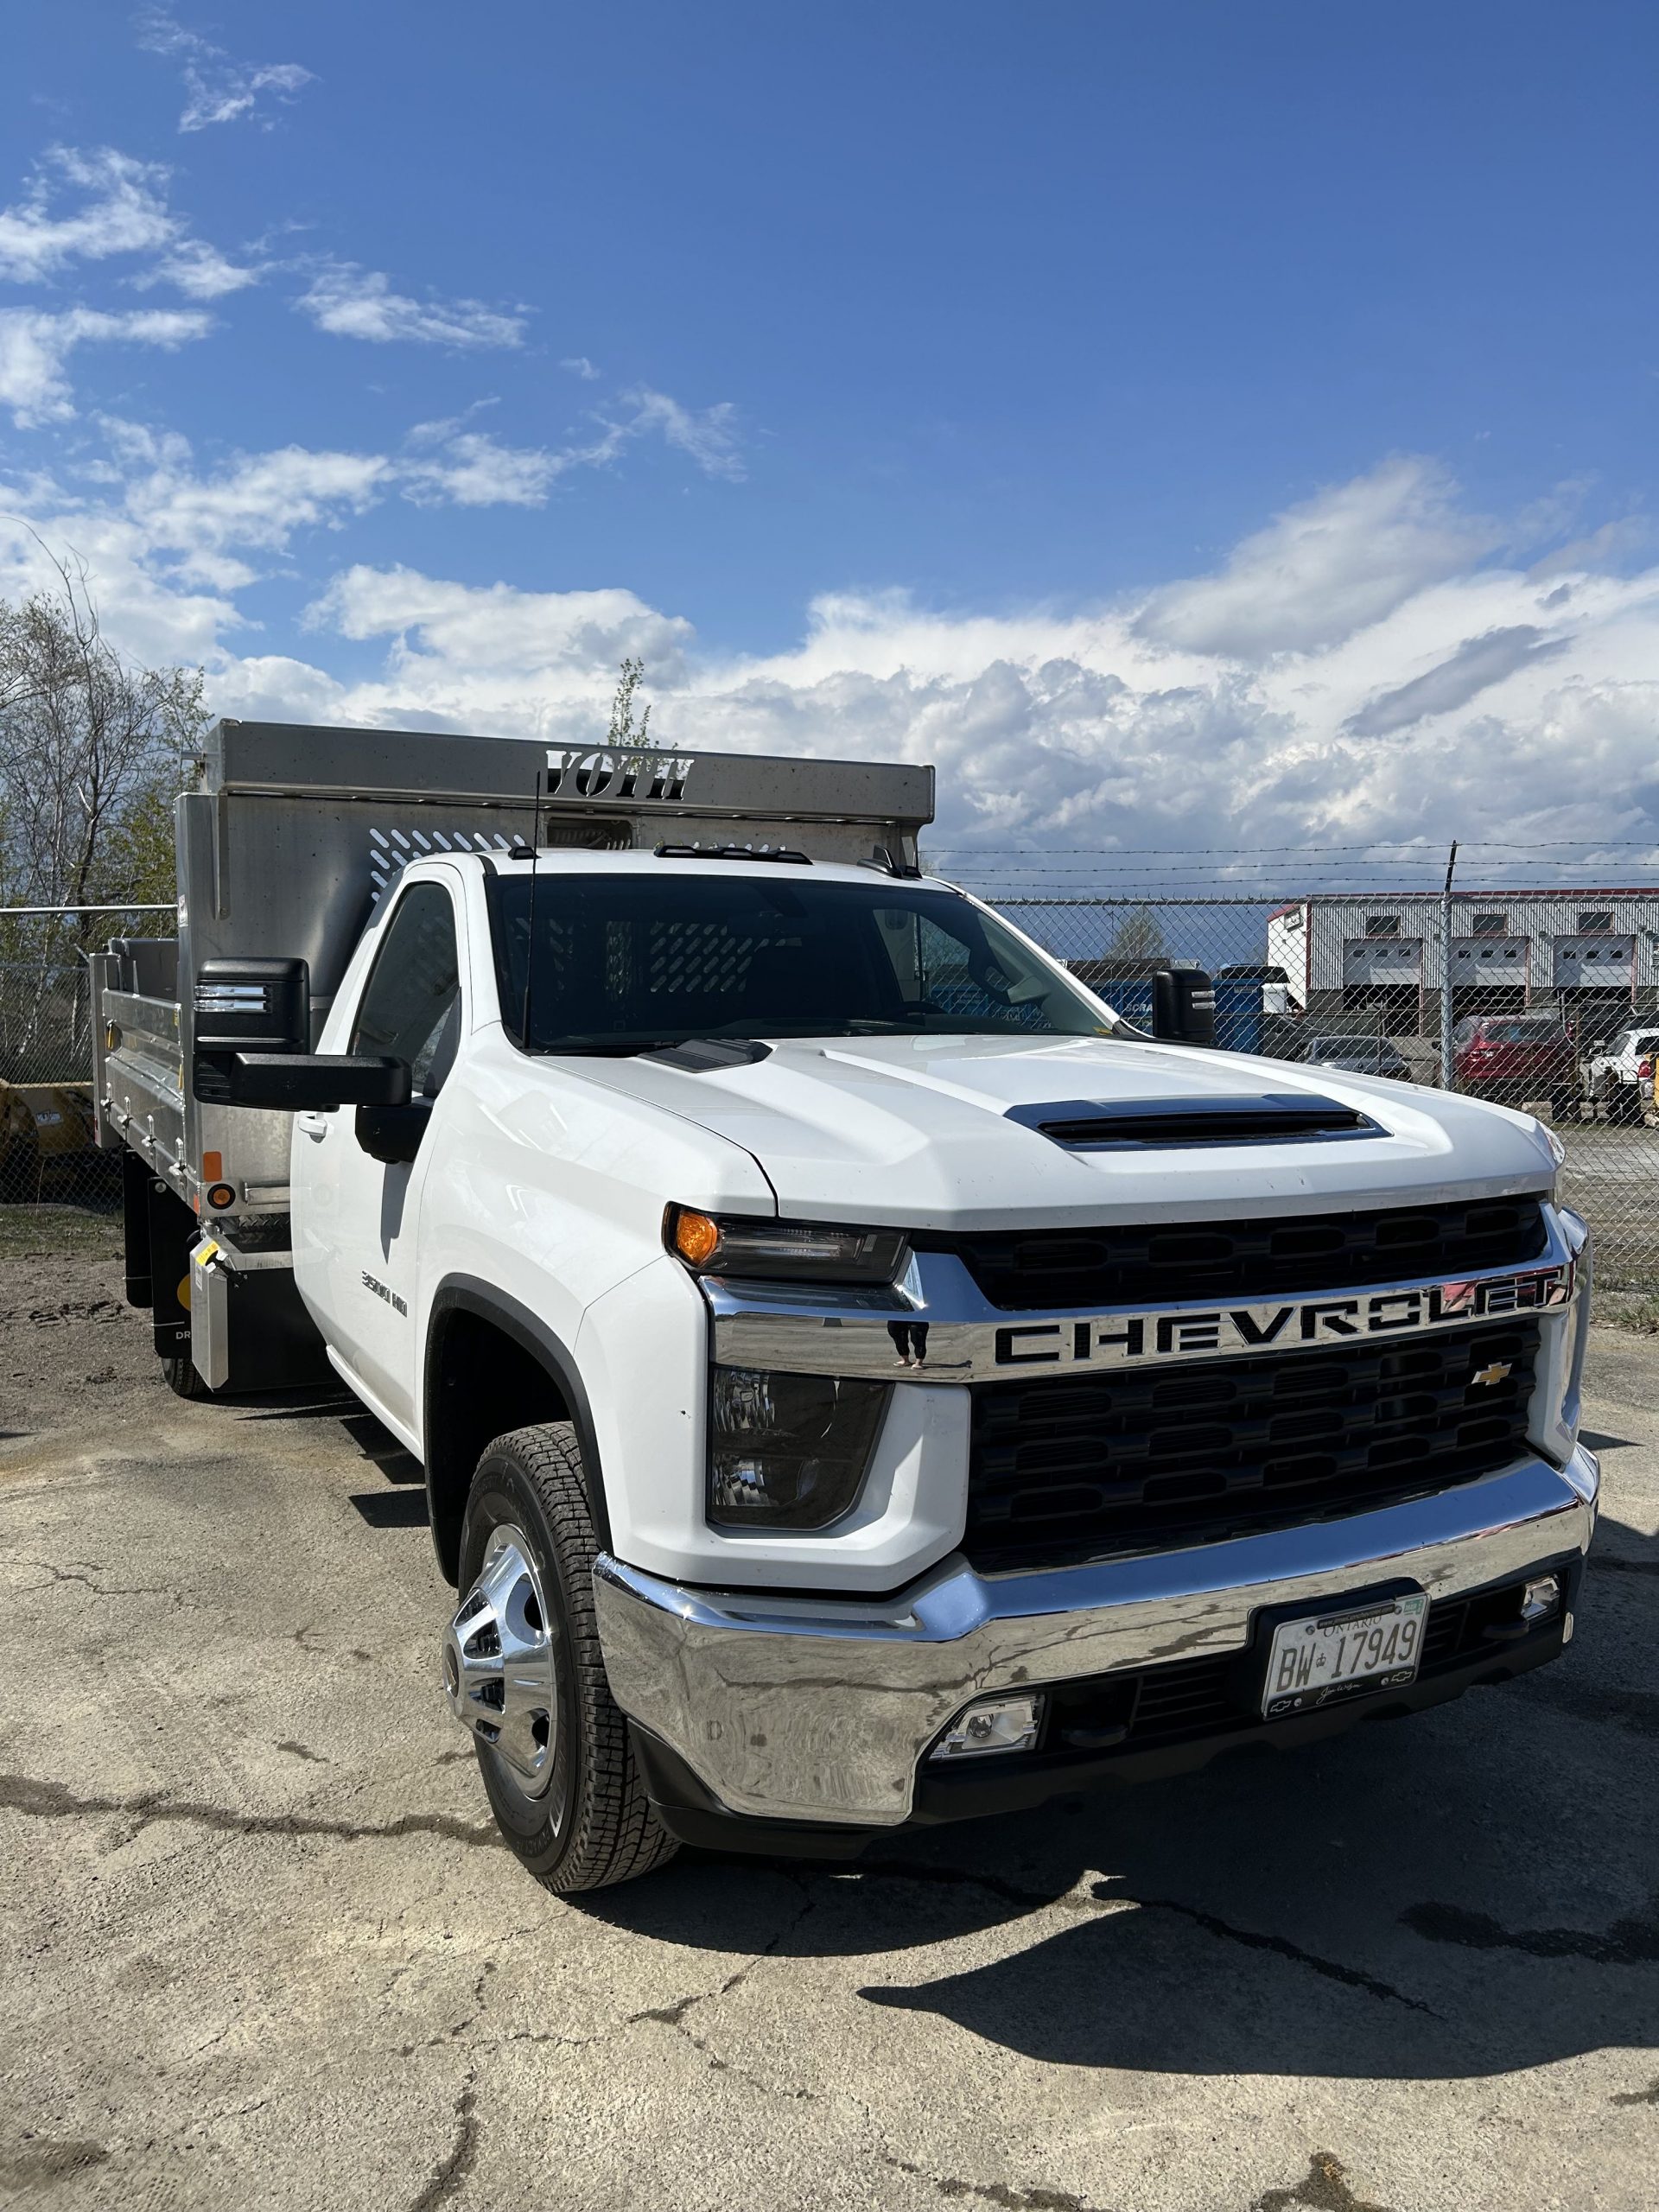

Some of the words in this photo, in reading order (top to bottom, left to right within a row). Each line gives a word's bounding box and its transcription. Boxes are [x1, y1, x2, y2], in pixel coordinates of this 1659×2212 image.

[545, 749, 695, 801] VOTH
[995, 1269, 1560, 1364] CHEVROLET
[1275, 1643, 1317, 1693] BW
[1331, 1619, 1418, 1680] 17949
